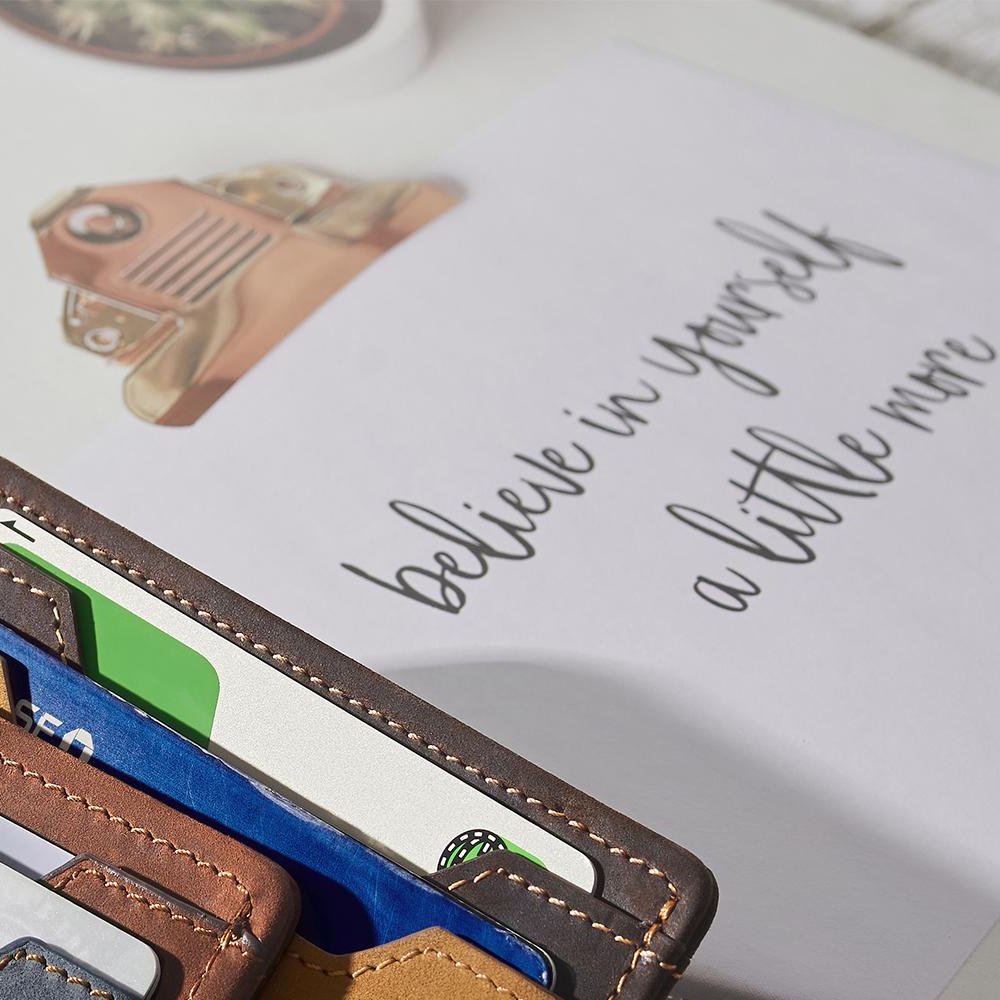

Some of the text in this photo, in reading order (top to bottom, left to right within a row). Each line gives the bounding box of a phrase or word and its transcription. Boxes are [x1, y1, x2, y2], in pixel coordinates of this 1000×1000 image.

[340, 208, 905, 615] believe in yourself
[665, 334, 997, 612] a little more
